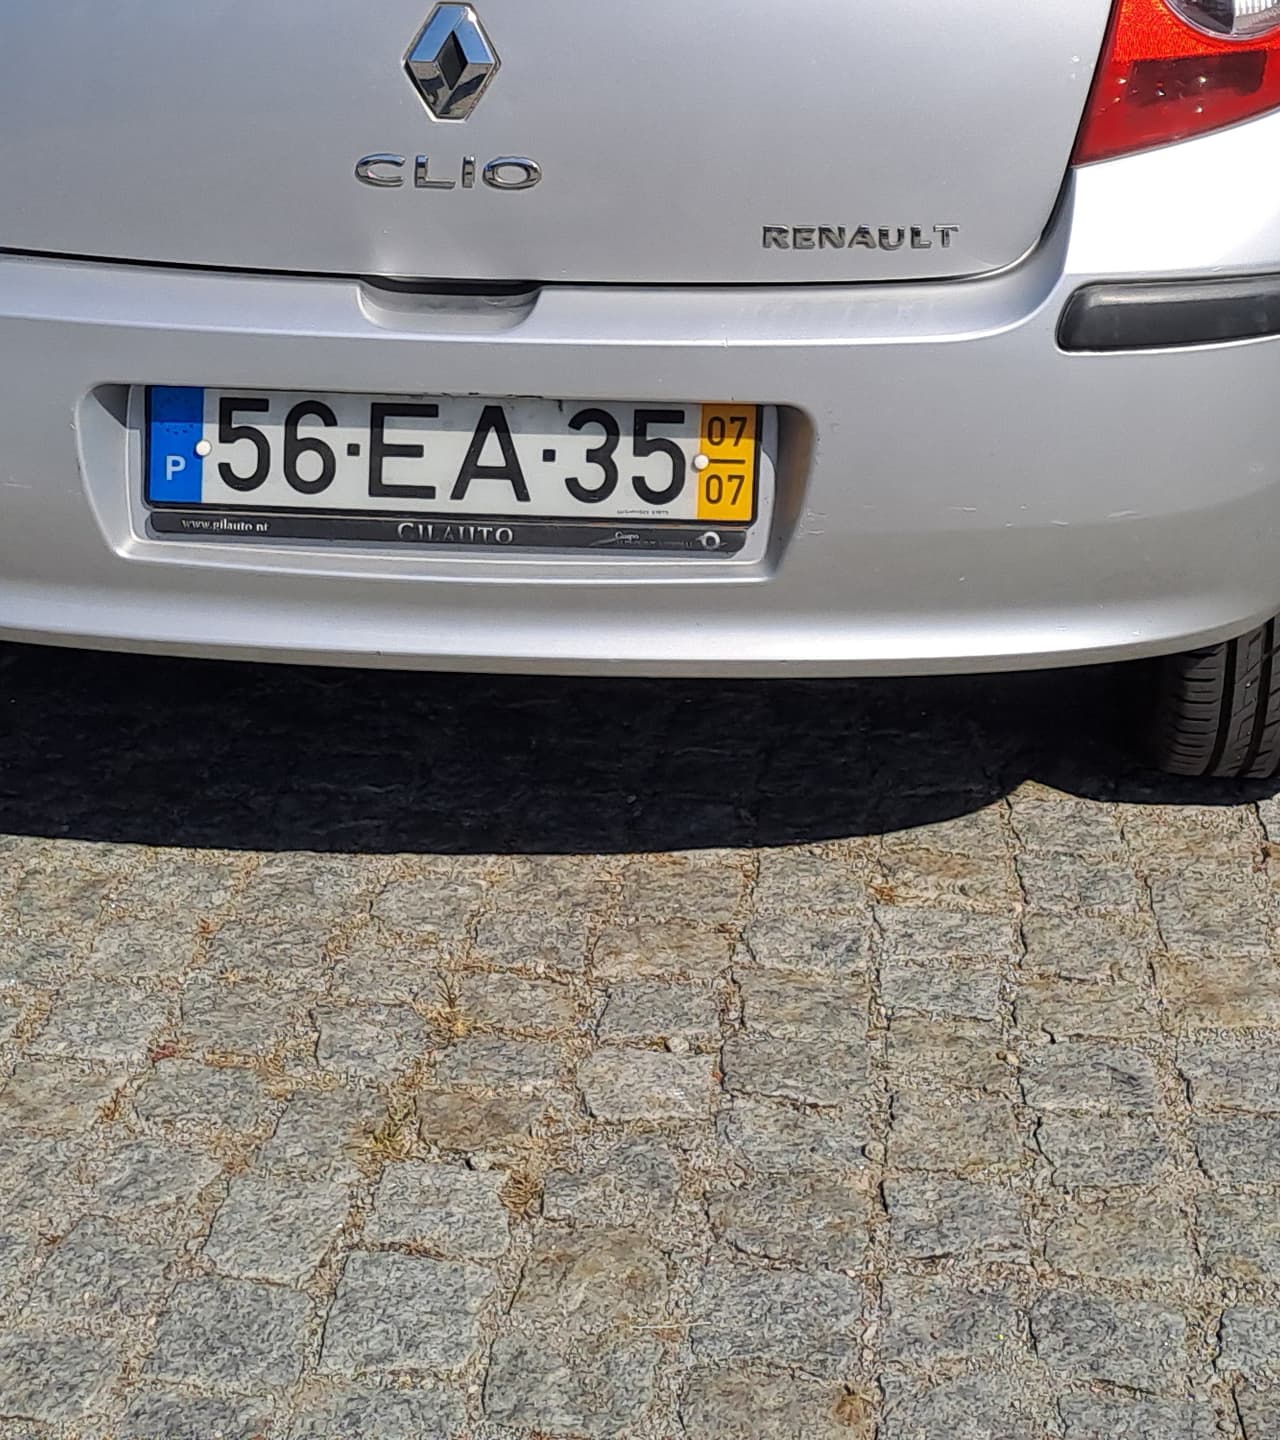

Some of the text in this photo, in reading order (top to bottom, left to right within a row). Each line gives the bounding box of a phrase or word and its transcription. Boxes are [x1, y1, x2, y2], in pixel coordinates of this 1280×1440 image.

[354, 152, 544, 190] CLIO
[761, 222, 961, 251] RENAULT
[707, 415, 749, 448] 07
[165, 454, 186, 481] P
[704, 473, 745, 506] 07
